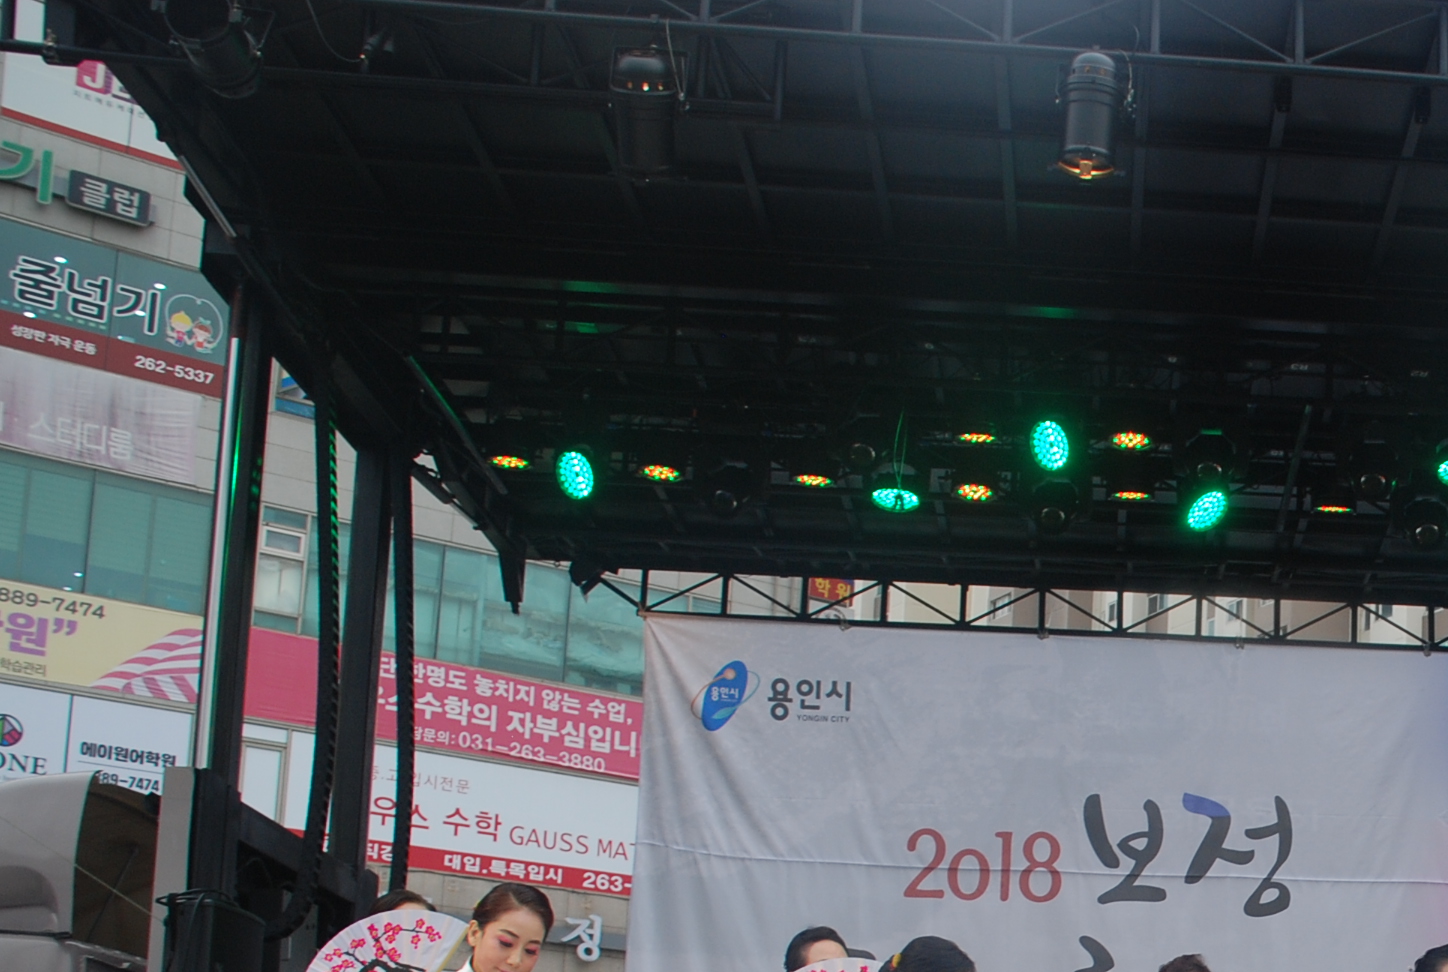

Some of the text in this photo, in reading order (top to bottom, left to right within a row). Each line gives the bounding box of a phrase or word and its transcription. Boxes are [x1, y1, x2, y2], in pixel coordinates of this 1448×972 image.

[80, 176, 141, 220] 클럽
[8, 256, 160, 335] 줄넘기
[73, 339, 97, 356] 운동
[134, 354, 215, 385] 262-5337
[27, 411, 134, 460] 스터디룸
[0, 611, 78, 657] 원”
[474, 672, 536, 706] 놓치지
[541, 688, 582, 716] 않는
[586, 700, 634, 726] 수업,
[710, 685, 740, 702] 용인시
[767, 677, 853, 721] 용인시
[797, 714, 850, 723] YONGIN CITY
[80, 740, 177, 768] 에이원어학원
[443, 806, 503, 842] 수학
[508, 825, 636, 861] GAUSS MA
[443, 853, 563, 884] 대입.특목입시
[902, 791, 1294, 918] 2018 보정
[560, 913, 603, 962] 정
